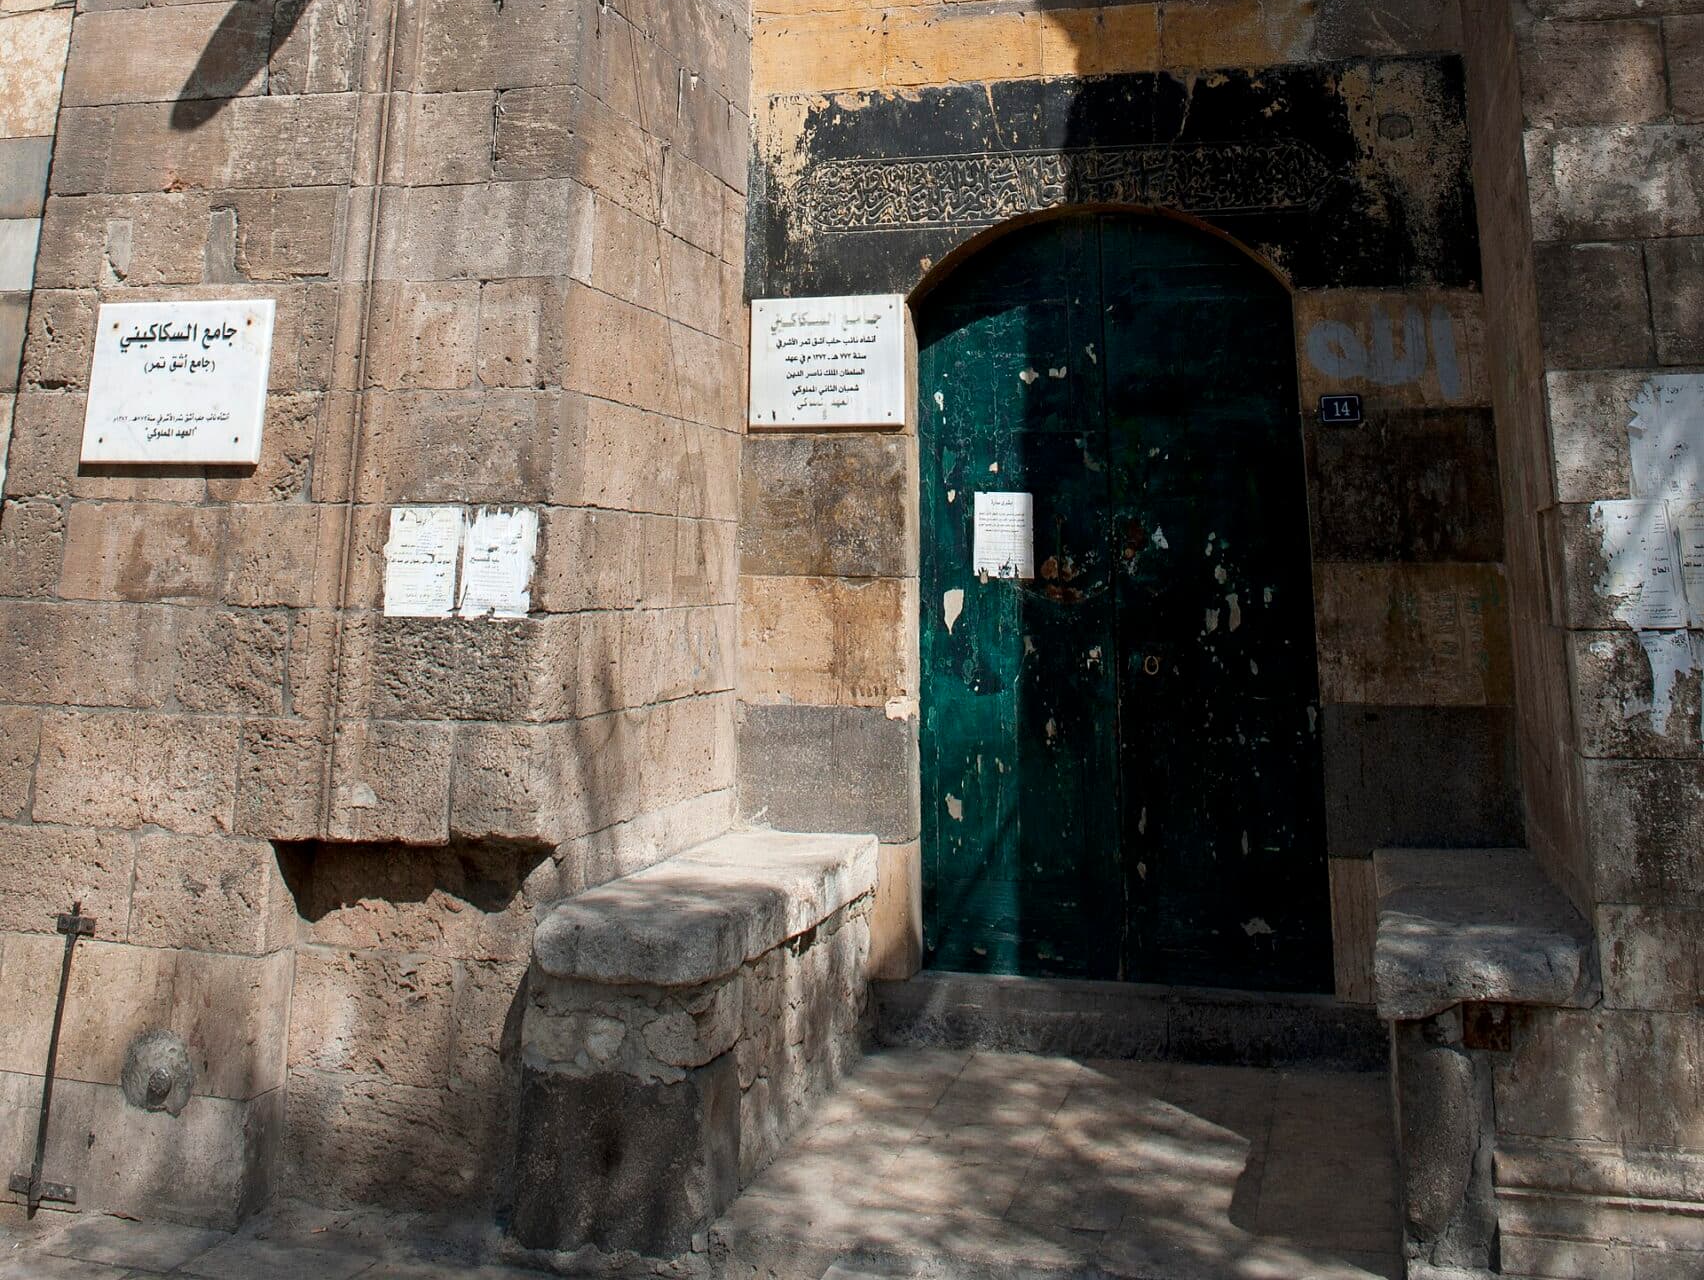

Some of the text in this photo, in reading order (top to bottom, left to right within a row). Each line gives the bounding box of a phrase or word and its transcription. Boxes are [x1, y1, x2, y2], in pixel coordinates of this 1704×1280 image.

[119, 321, 238, 353] جامع السكاكيني
[852, 351, 867, 360] سنة
[1306, 303, 1462, 401] الله
[838, 383, 860, 393] شعبان
[1333, 400, 1351, 417] 14
